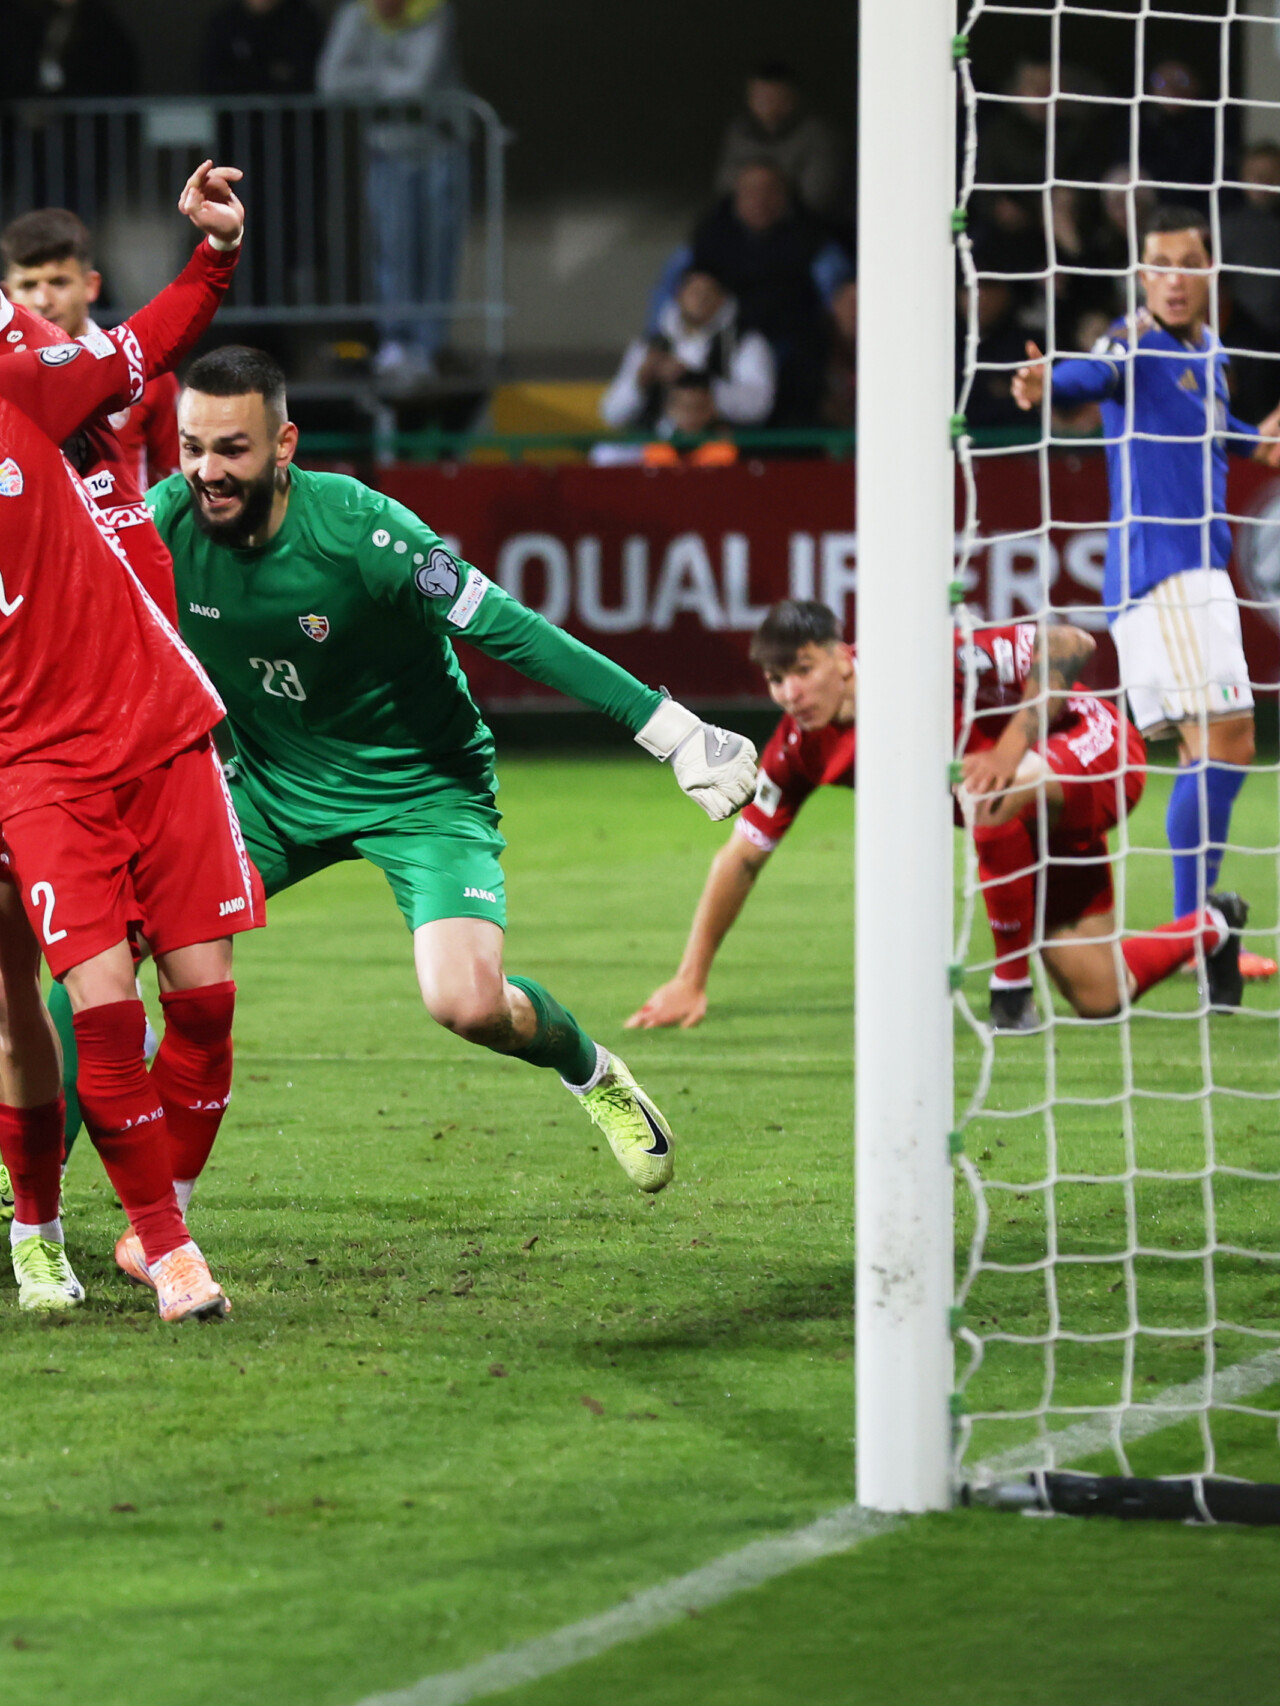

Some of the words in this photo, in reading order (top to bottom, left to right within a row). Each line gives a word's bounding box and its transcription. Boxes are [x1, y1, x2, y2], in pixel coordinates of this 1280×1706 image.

[189, 602, 220, 619] JAKO
[249, 657, 307, 701] 23
[219, 896, 246, 916] JAKO
[463, 886, 497, 904] JAKO
[31, 881, 68, 945] 2
[120, 1105, 164, 1131] JAKO
